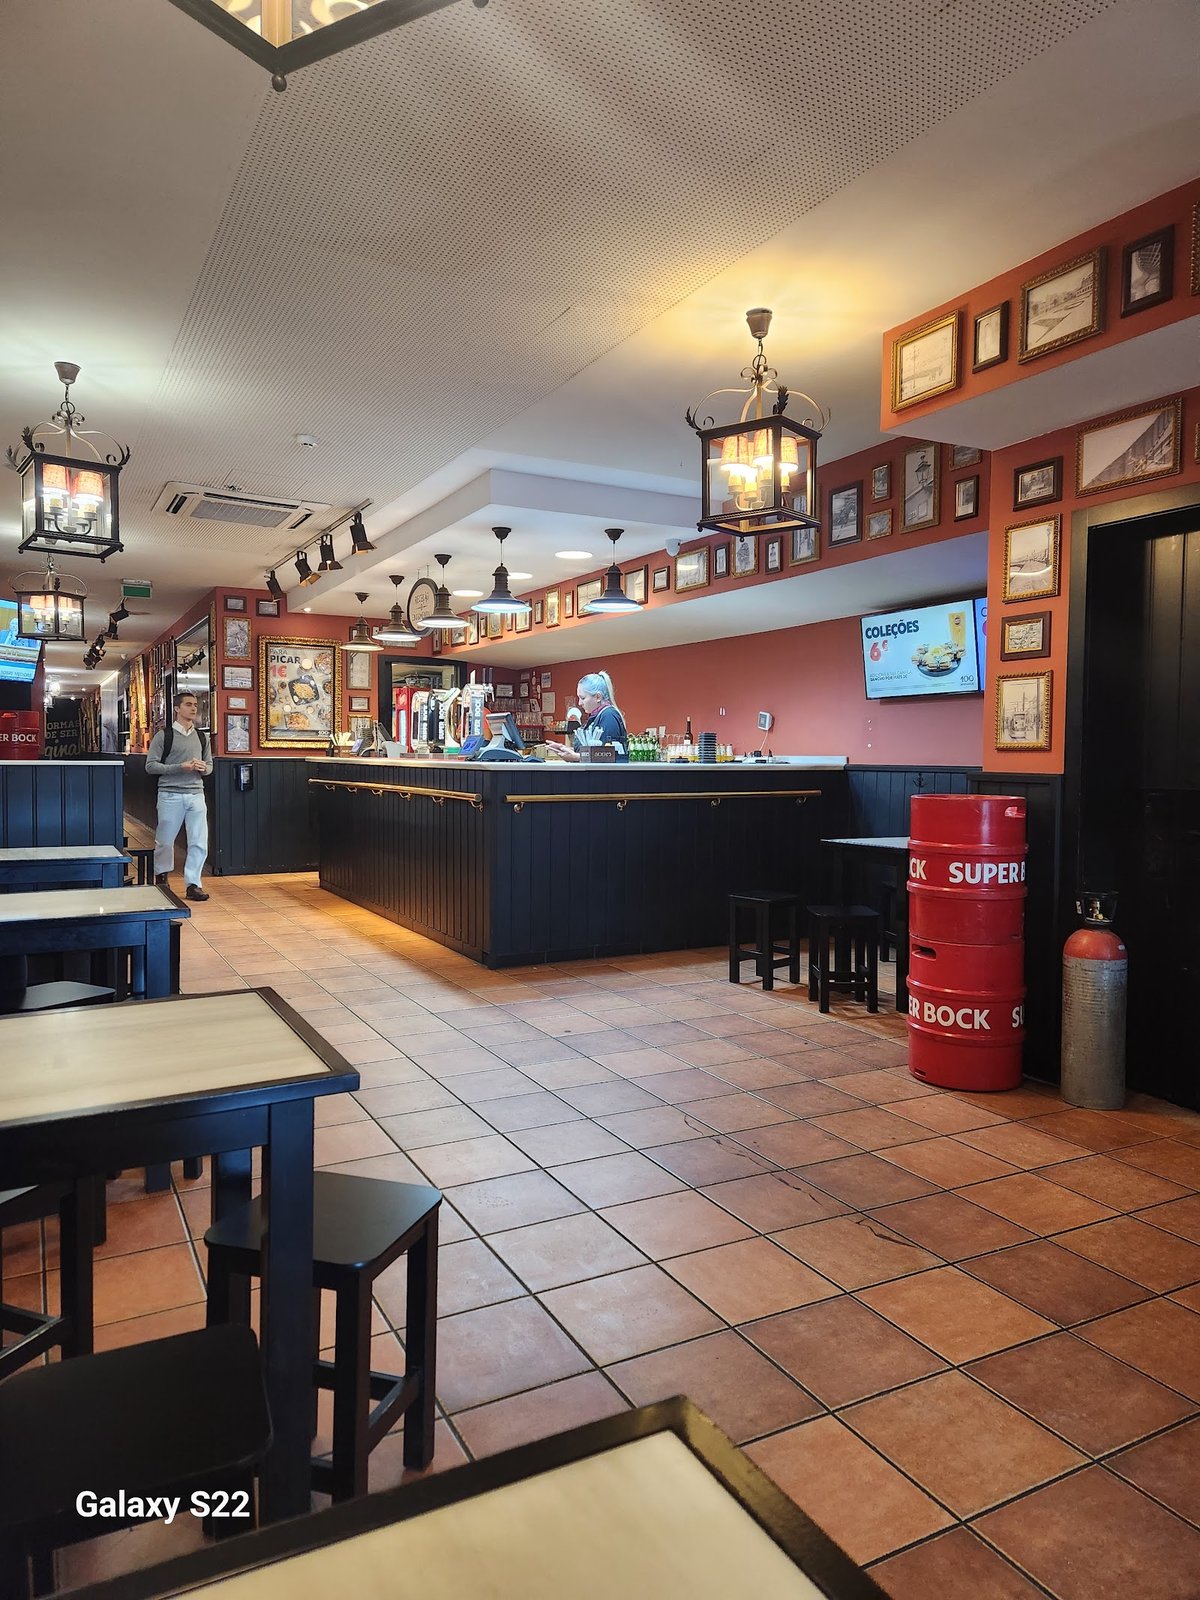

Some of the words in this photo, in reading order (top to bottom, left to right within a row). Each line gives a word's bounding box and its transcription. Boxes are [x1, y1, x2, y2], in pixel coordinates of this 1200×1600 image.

[865, 619, 919, 639] COLEÇÕES
[270, 655, 300, 664] PICAR
[271, 665, 287, 677] 1€
[11, 733, 37, 742] BOCK
[60, 729, 78, 738] SER
[948, 861, 1019, 884] SUPER
[923, 1001, 991, 1030] BOCK
